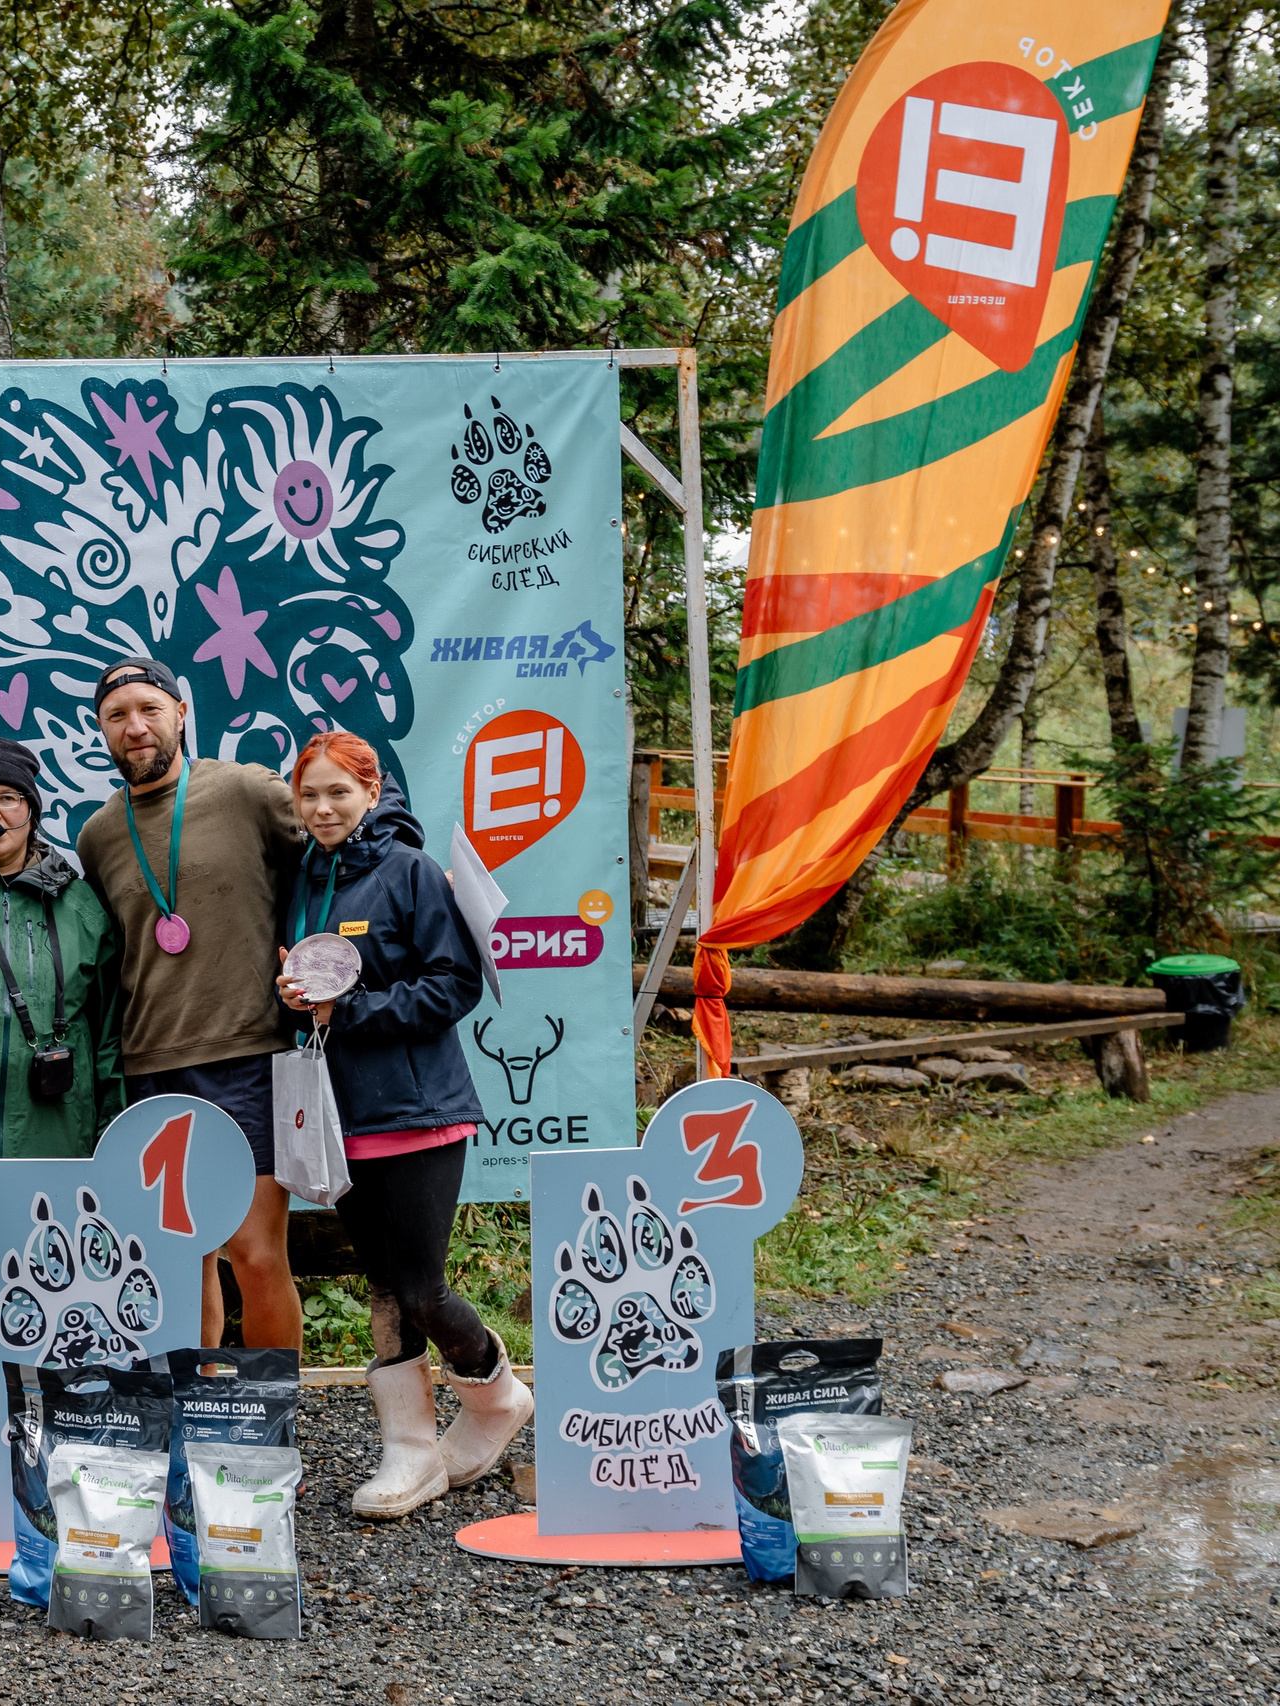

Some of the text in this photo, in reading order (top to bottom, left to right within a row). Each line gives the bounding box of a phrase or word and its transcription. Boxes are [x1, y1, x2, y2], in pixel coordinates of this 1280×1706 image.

[468, 528, 573, 565] СИБИРСКИЙ
[430, 635, 549, 662] ЖИВАЯ
[516, 662, 568, 678] СИЛА
[452, 698, 506, 755] СЕКТОР
[341, 925, 366, 933] Josera
[491, 929, 587, 960] ОРИЯ
[482, 1155, 530, 1167] apres-s
[679, 1101, 765, 1214] 3
[141, 1110, 195, 1236] 1
[766, 1386, 849, 1405] ЖИВАЯ СИЛА
[183, 1400, 267, 1414] ЖИВАЯ СИЛА
[54, 1409, 141, 1426] ЖИВАЯ СИЛА
[565, 1405, 724, 1449] СИБИРСКИЙ
[83, 1473, 134, 1489] VitaGreenka
[225, 1472, 273, 1487] VitaGreenka
